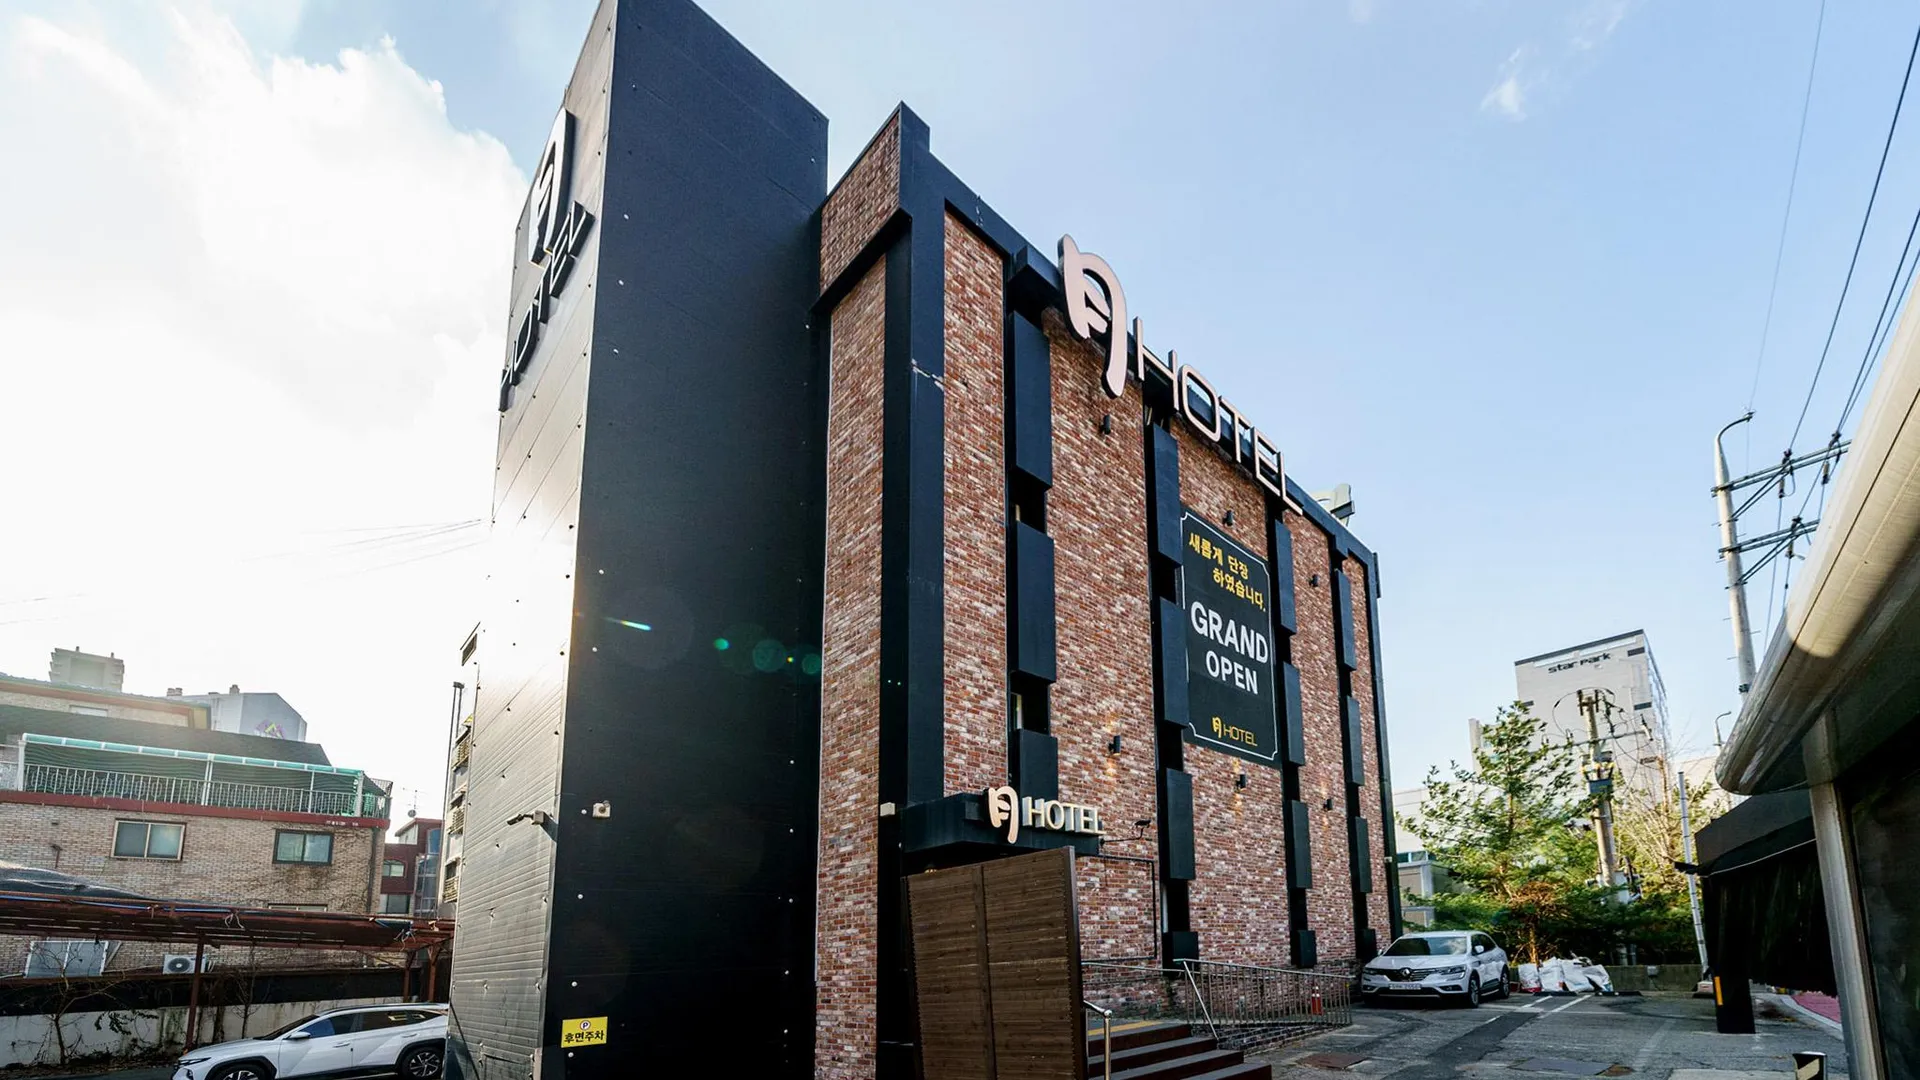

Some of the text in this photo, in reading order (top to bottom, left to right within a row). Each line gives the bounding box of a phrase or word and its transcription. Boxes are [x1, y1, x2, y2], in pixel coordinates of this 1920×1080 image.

[1133, 316, 1303, 516] HOTEL
[1189, 532, 1249, 580] 새롭게 단장
[1212, 567, 1266, 612] 하였습니다.
[1190, 600, 1269, 664] GRAND
[1205, 650, 1258, 695] OPEN
[1223, 725, 1258, 747] HOTEL
[1022, 796, 1107, 836] HOTEL
[564, 1030, 605, 1043] 후면주차
